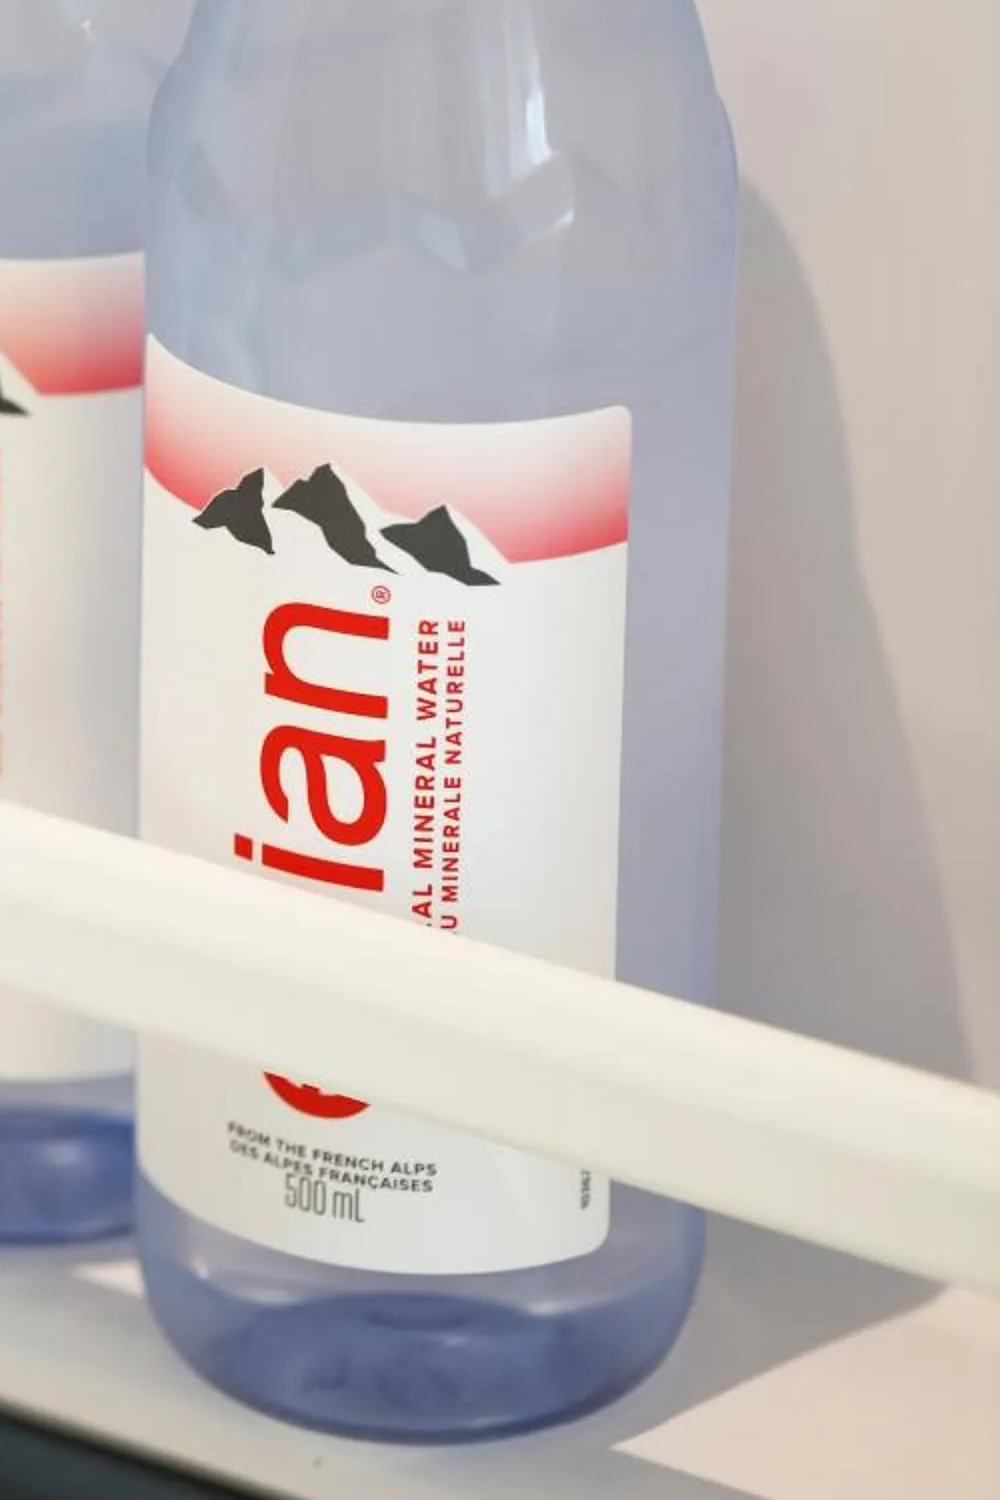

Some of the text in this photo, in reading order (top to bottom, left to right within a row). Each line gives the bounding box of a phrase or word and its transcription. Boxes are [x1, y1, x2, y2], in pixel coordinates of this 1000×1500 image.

[415, 619, 440, 722] WATER
[444, 620, 466, 765] NATURELLE
[412, 736, 437, 870] MINERAL
[440, 776, 463, 904] MINERALE
[227, 1120, 438, 1178] FROM THE FRENCH ALPS
[229, 1138, 434, 1193] DES ALPES FRANÇAISES
[284, 1173, 366, 1224] 500 mL
